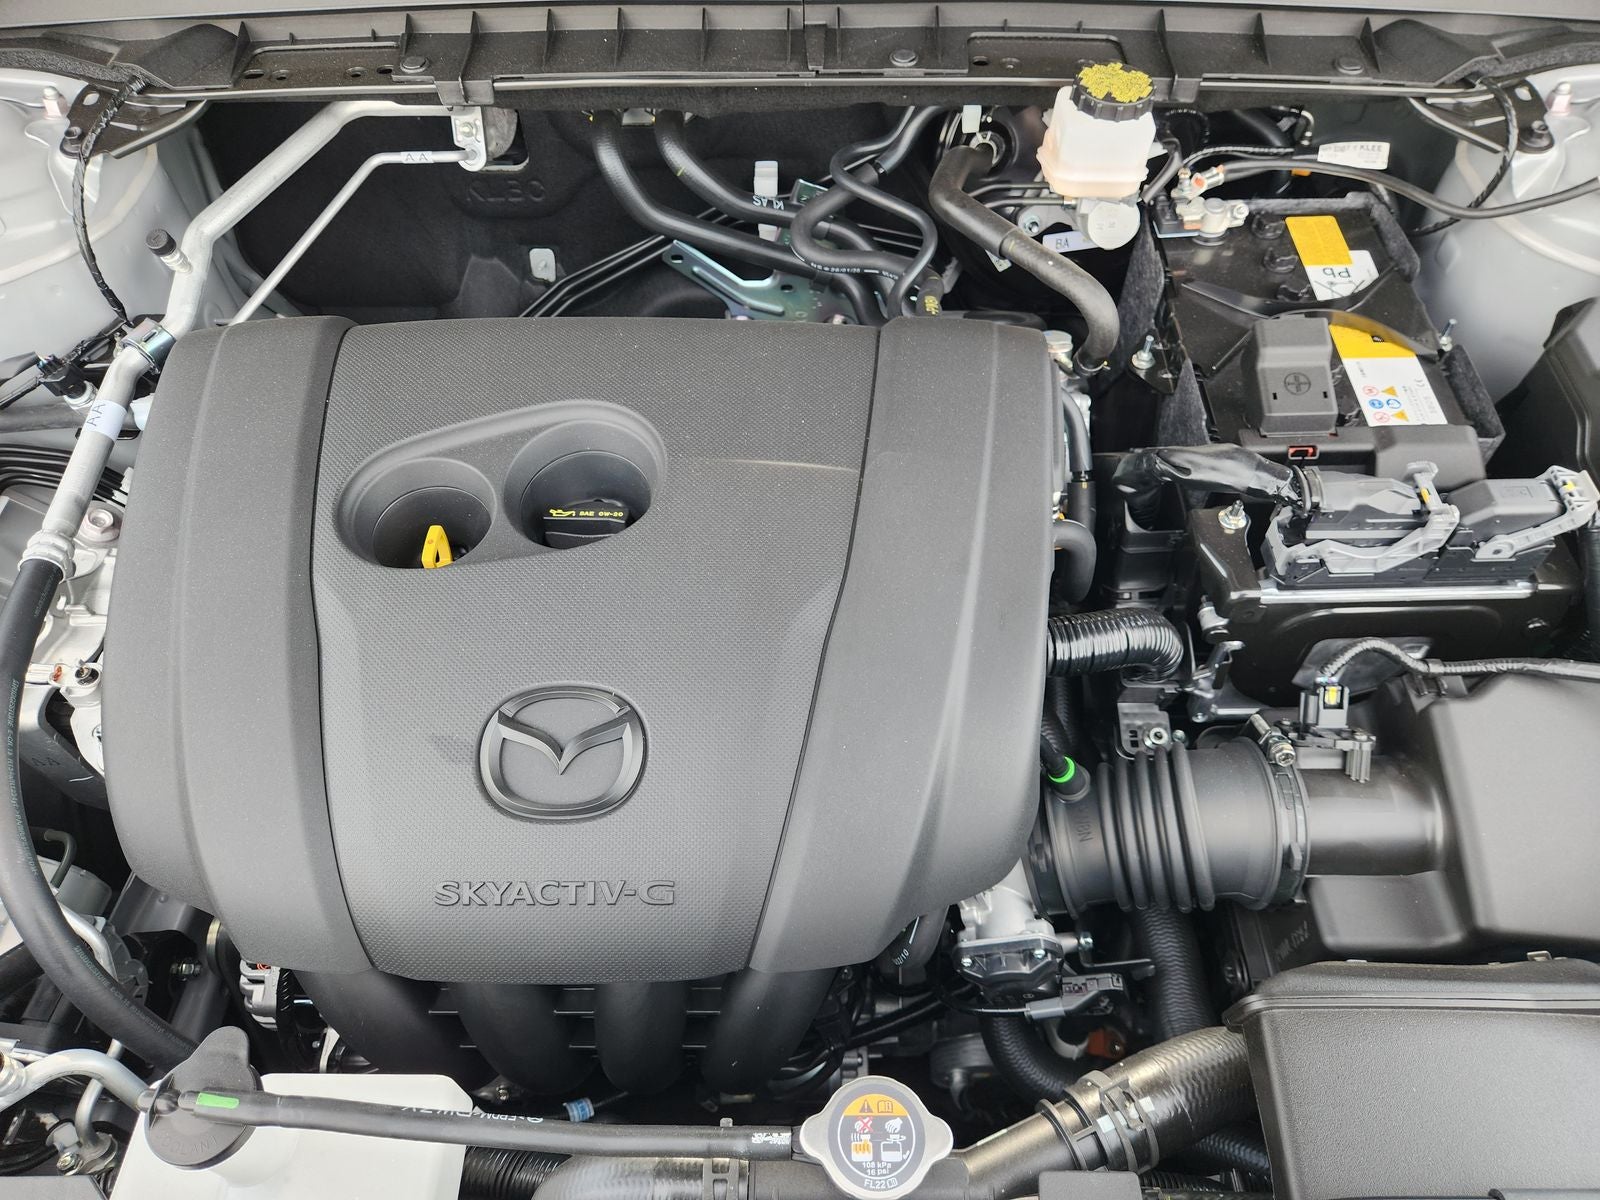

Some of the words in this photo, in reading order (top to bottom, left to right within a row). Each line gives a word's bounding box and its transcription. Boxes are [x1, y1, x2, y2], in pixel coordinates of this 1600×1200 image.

[405, 152, 428, 162] AA
[1322, 267, 1351, 278] Pb
[86, 403, 106, 427] AA
[434, 880, 675, 906] SKYACTIV-G
[877, 1161, 892, 1169] kPa
[864, 1178, 886, 1189] FL22
